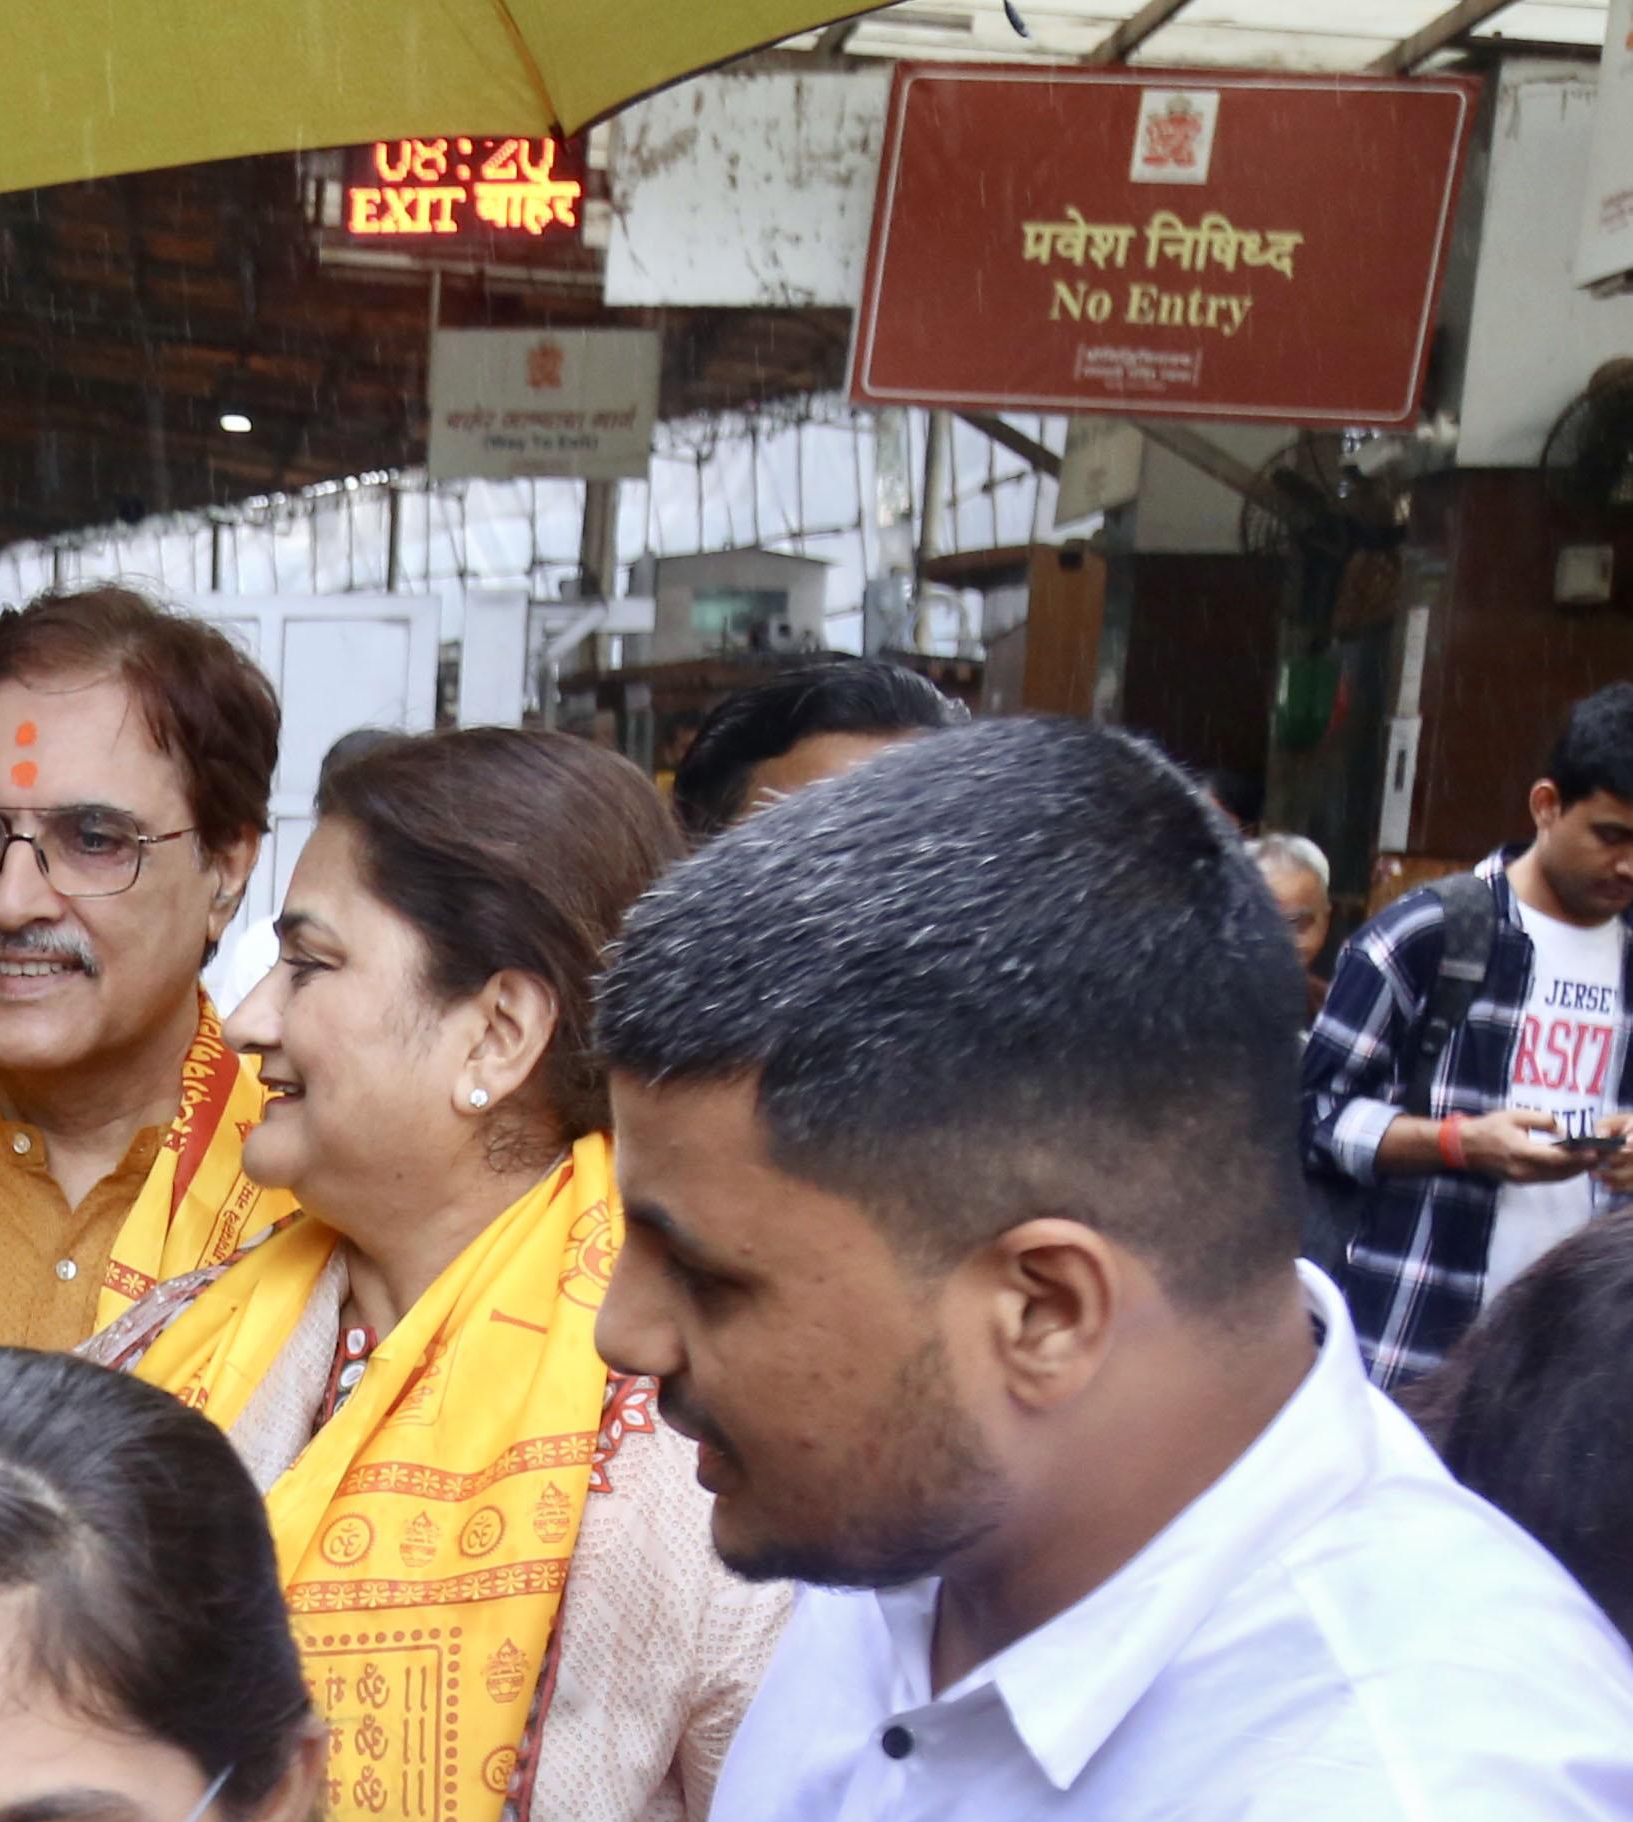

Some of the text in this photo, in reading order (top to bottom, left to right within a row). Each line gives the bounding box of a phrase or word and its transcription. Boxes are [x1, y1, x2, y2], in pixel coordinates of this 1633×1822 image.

[348, 186, 467, 233] EXIT
[1021, 205, 1137, 270] प्रवेश
[1049, 280, 1254, 338] No Entry
[1545, 979, 1619, 1015] JERSE
